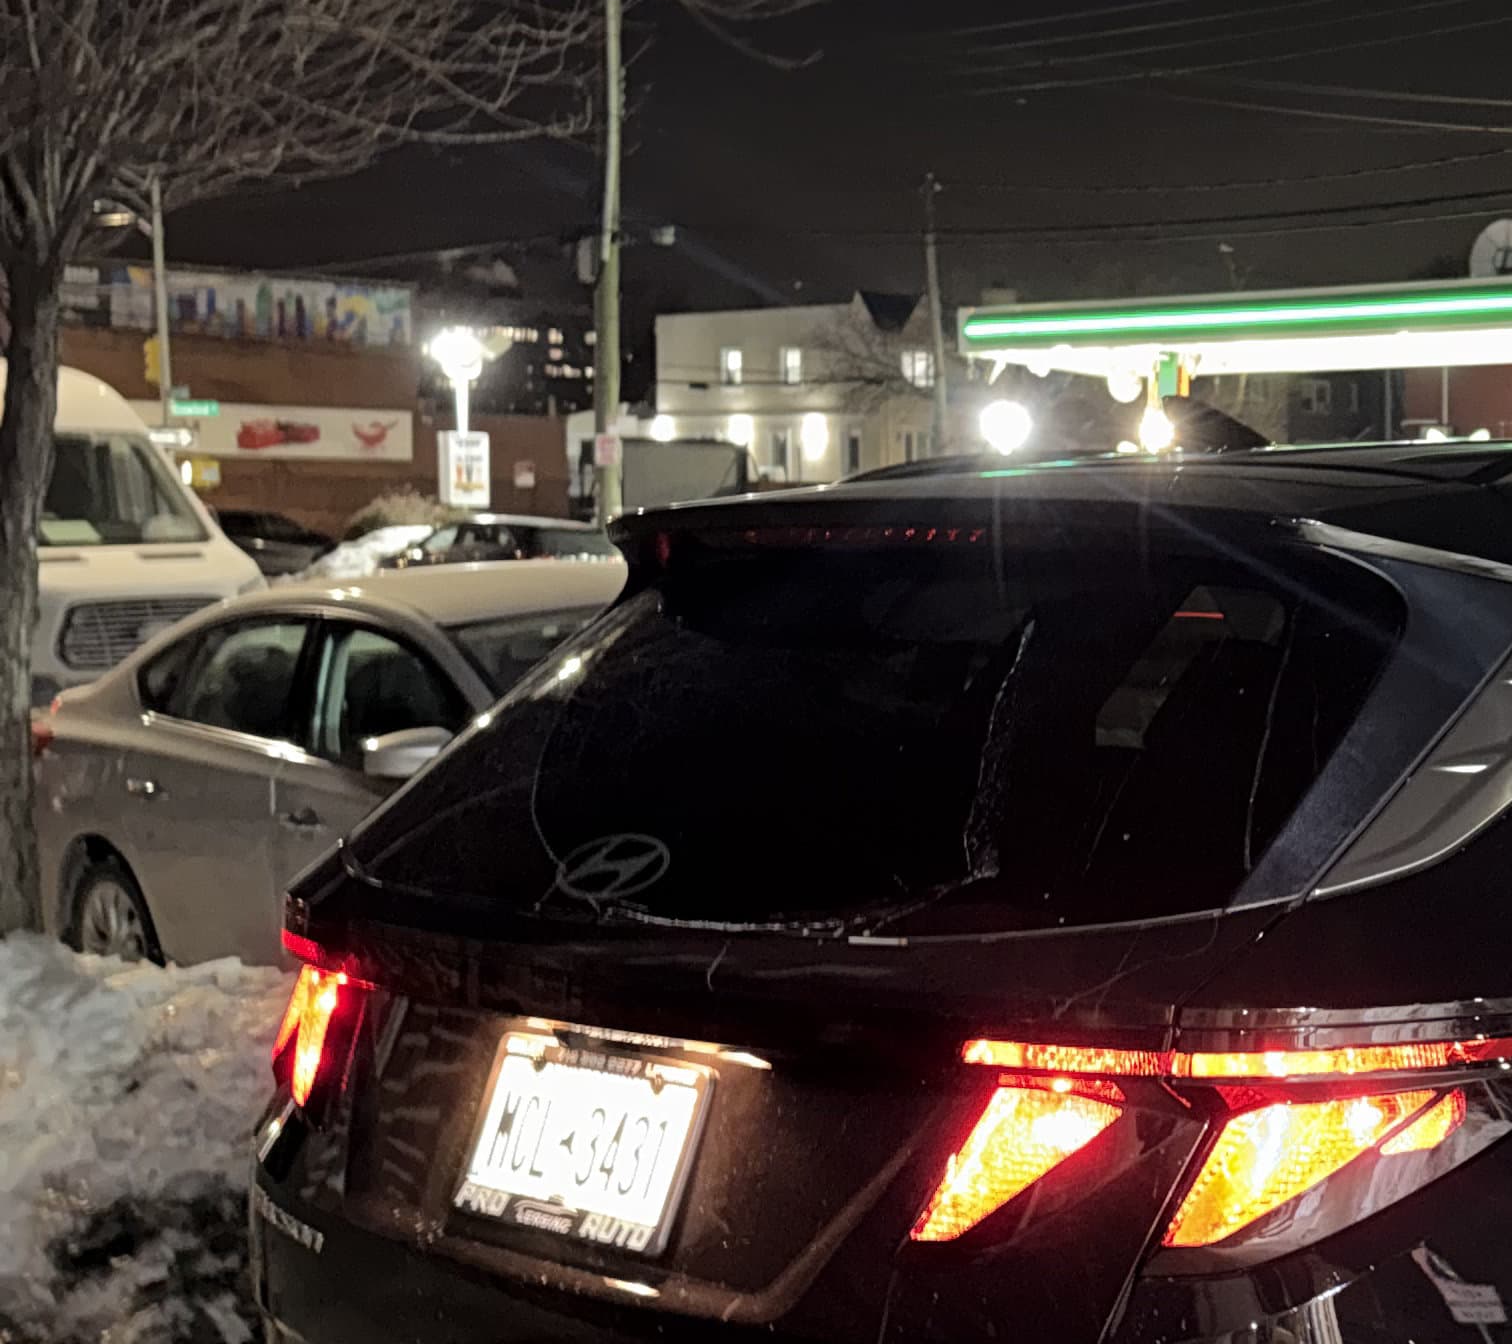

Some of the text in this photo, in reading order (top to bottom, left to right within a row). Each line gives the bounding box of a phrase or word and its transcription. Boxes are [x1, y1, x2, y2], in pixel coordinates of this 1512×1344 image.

[574, 1107, 668, 1200] 3431
[454, 1182, 511, 1217] PRO
[578, 1213, 656, 1252] AUTO
